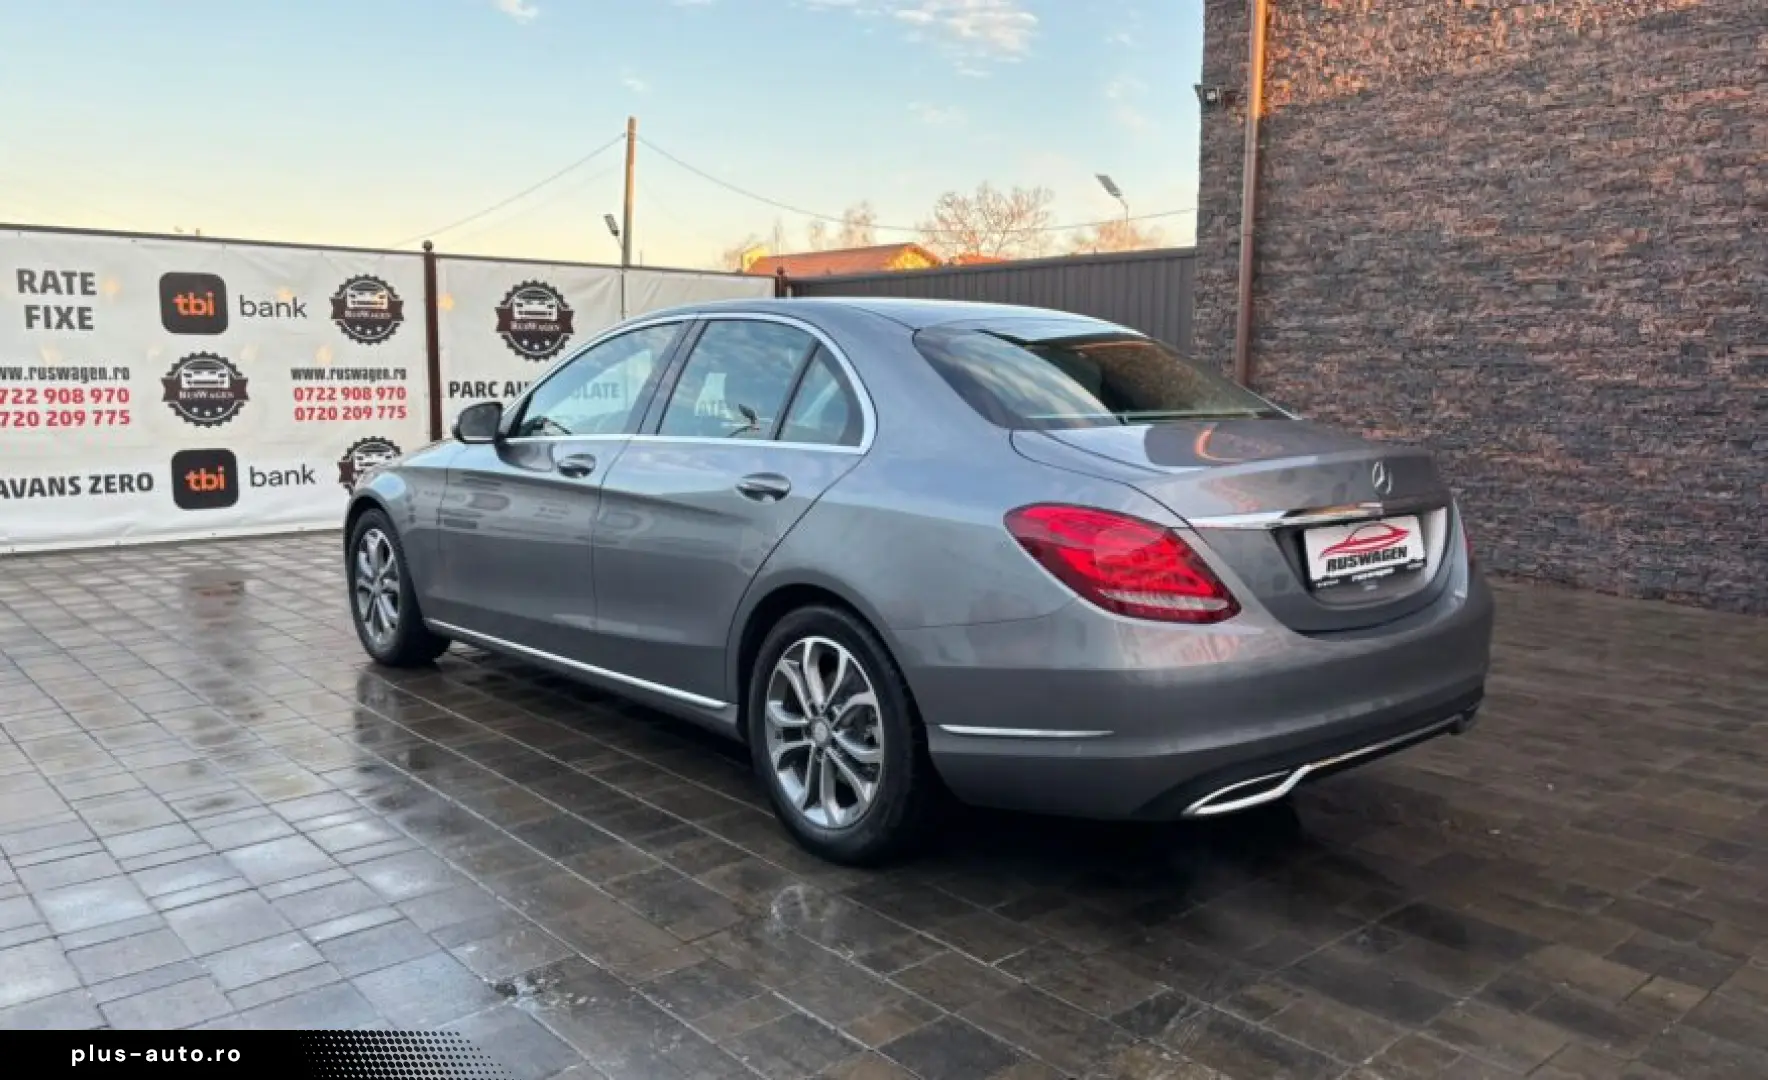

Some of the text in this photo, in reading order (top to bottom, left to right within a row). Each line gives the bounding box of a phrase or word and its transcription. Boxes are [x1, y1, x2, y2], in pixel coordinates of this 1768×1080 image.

[16, 268, 98, 296] RATE
[172, 291, 308, 319] tbi bank
[24, 304, 95, 331] FIXE
[290, 367, 407, 384] www.ruswagen.ro
[43, 387, 86, 405] 908
[90, 387, 130, 405] 970
[293, 386, 407, 402] 0722 908 970
[448, 380, 499, 399] PARC
[45, 409, 86, 427] 209
[92, 408, 131, 426] 775
[293, 405, 407, 421] 0720 209 775
[0, 472, 155, 500] AVANS ZERO
[184, 464, 316, 492] tbi bank
[1326, 546, 1408, 572] RUSWAGEN
